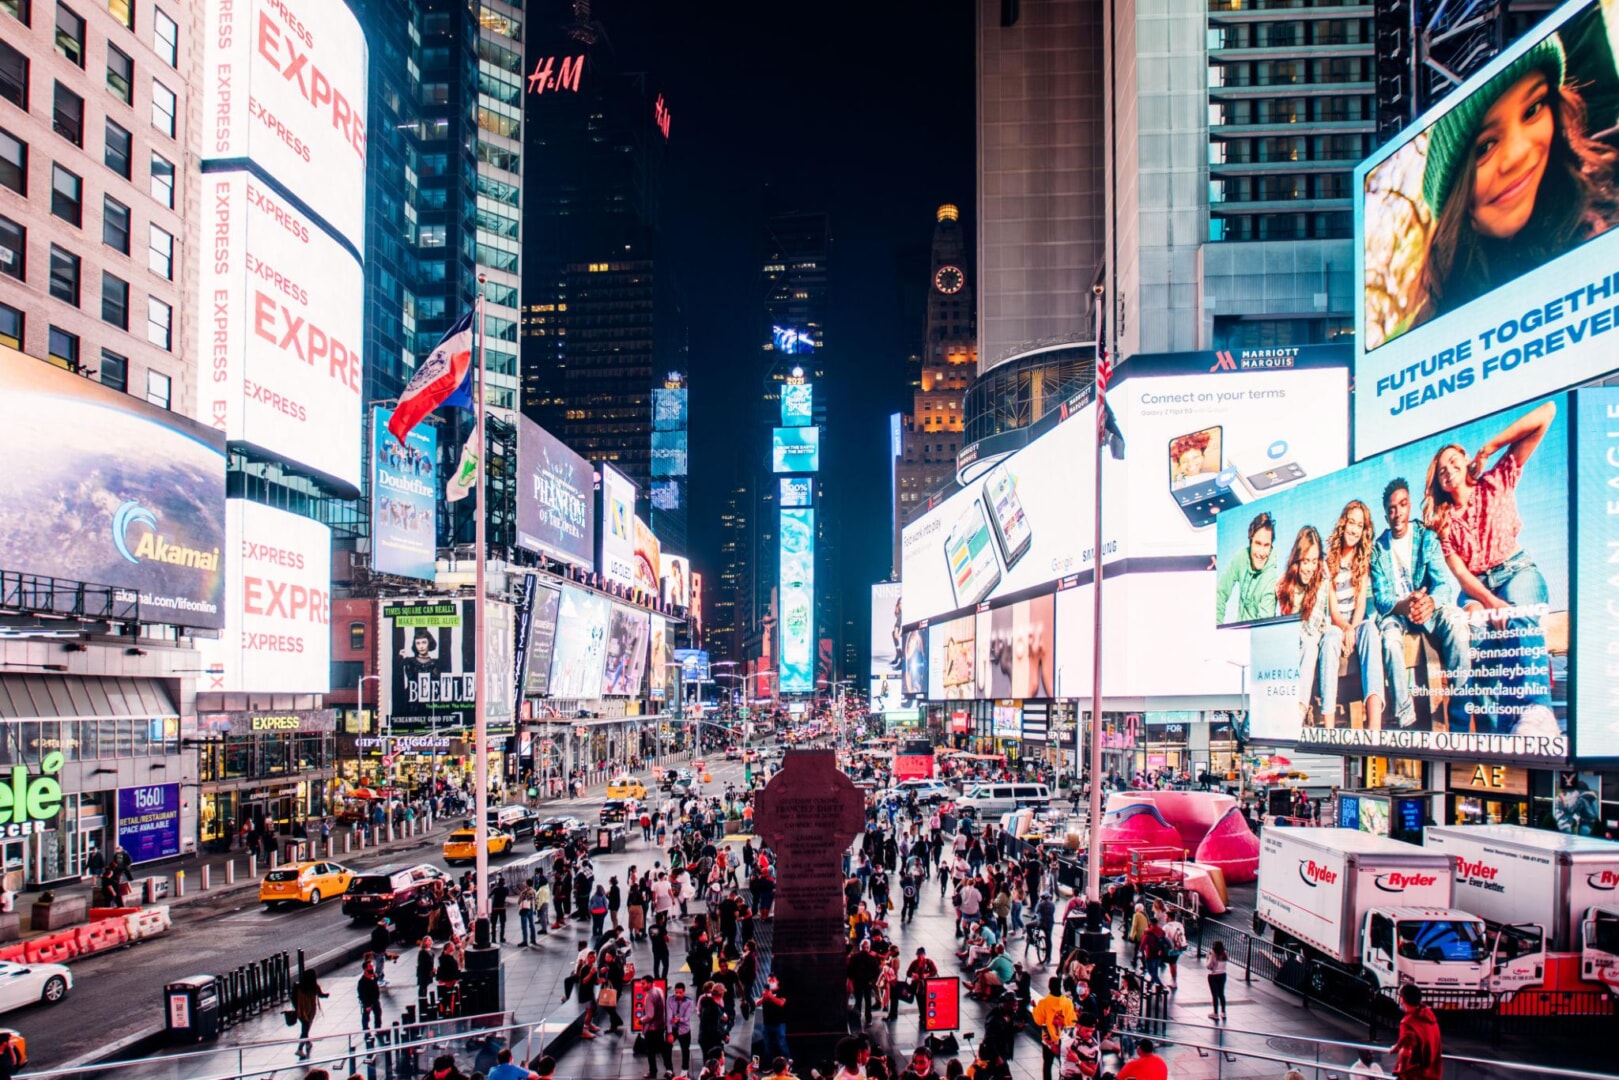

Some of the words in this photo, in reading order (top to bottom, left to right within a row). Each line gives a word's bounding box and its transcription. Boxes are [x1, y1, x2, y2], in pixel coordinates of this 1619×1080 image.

[258, 9, 364, 161] EXPRE
[528, 55, 584, 94] H&M
[216, 63, 231, 153] EXPRESS
[249, 96, 310, 163] EXPRESS
[246, 184, 309, 244] EXPRESS
[214, 182, 230, 275] EXPRESS
[245, 252, 308, 306] EXPRESS
[213, 289, 228, 383] EXPRESS
[255, 289, 362, 395] EXPRE
[1242, 348, 1299, 358] MARRIOTT
[1242, 358, 1293, 368] MARQUIS
[1390, 367, 1475, 416] JEANS
[1483, 305, 1619, 380] FOREVE
[1377, 340, 1472, 397] FUTURE
[243, 379, 307, 423] EXPRESS
[1141, 391, 1195, 405] Connect
[1197, 391, 1213, 402] on
[1218, 390, 1245, 404] your
[1248, 388, 1286, 400] terms
[379, 469, 434, 497] Doubtfire
[533, 474, 585, 528] PHANTOM
[135, 531, 220, 571] Akamai
[242, 540, 305, 570] EXPRESS
[1083, 541, 1117, 562] SAUNG
[385, 606, 401, 616] TIMES
[401, 606, 422, 616] SQUARE
[422, 605, 434, 614] CAN
[434, 604, 455, 614] REALLY
[398, 617, 414, 625] MAKE
[427, 617, 441, 625] FEEL
[242, 632, 304, 653] EXPRESS
[1467, 646, 1547, 662] @jennaortega
[1257, 668, 1300, 681] AMERICA
[1267, 685, 1297, 697] EAGLE
[1411, 683, 1548, 699] @therealcalebmclaughlin
[253, 716, 299, 730] EXPRESS
[396, 738, 450, 747] LUGGAGE
[1301, 728, 1373, 745] AMERICAN
[1379, 729, 1431, 749] EAGLE
[1436, 732, 1566, 756] OUTFITTERS
[1471, 763, 1506, 789] AE
[134, 787, 159, 808] 1560
[1342, 798, 1357, 808] EASY
[119, 824, 138, 836] SPACE
[139, 819, 170, 833] AVAILABLE
[1307, 860, 1338, 885] Ryder
[1456, 855, 1498, 880] Ryder
[1389, 872, 1437, 889] Ryder
[1469, 877, 1483, 889] Ever
[1484, 880, 1505, 893] better.
